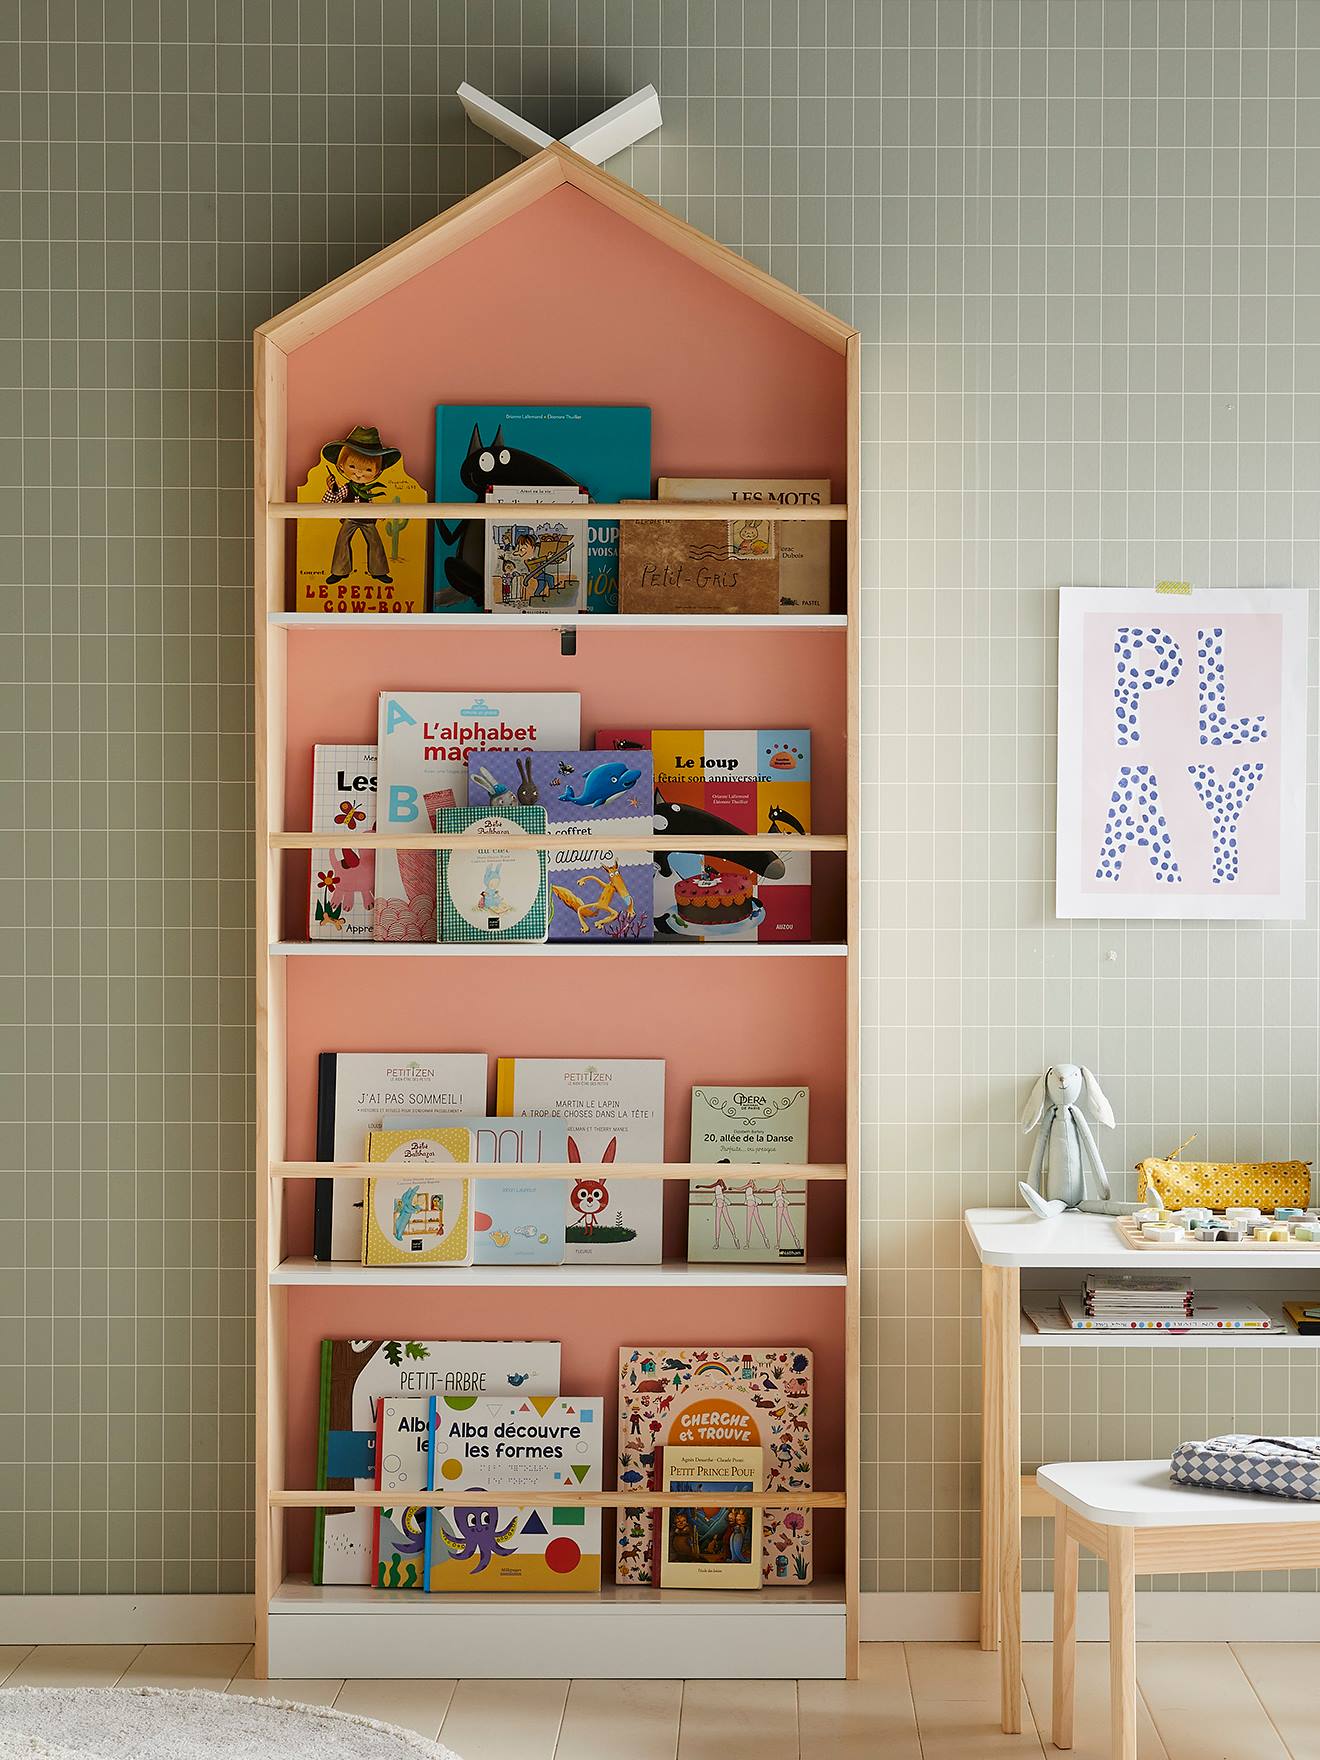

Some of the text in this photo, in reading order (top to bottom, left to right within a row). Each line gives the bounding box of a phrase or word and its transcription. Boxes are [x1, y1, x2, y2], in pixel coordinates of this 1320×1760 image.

[306, 585, 395, 599] LE PETIT
[324, 600, 415, 613] COW-BOY
[387, 700, 417, 735] A
[424, 722, 537, 745] L'alphabet
[675, 756, 739, 771] Le loup
[337, 770, 378, 792] Les
[658, 772, 772, 783] fêtait son anniversaire
[388, 785, 419, 823] B
[346, 924, 374, 934] Appre
[358, 1093, 380, 1104] J'AI
[385, 1093, 404, 1105] PAS
[555, 1100, 620, 1108] MARTIN LE LAPIN
[564, 1110, 593, 1118] CHOSES
[595, 1110, 615, 1118] DANS
[618, 1110, 628, 1118] LA
[631, 1109, 649, 1118] TÊTE
[704, 1133, 793, 1142] 20, allée de la Danse
[400, 1371, 487, 1391] PETIT-ARBRE
[681, 1411, 750, 1428] CHERCHE
[449, 1422, 581, 1438] Alba découvre
[679, 1427, 752, 1442] et TROUVE
[465, 1442, 563, 1458] les formes
[670, 1466, 695, 1476] PETIT
[697, 1466, 729, 1476] PRINCE
